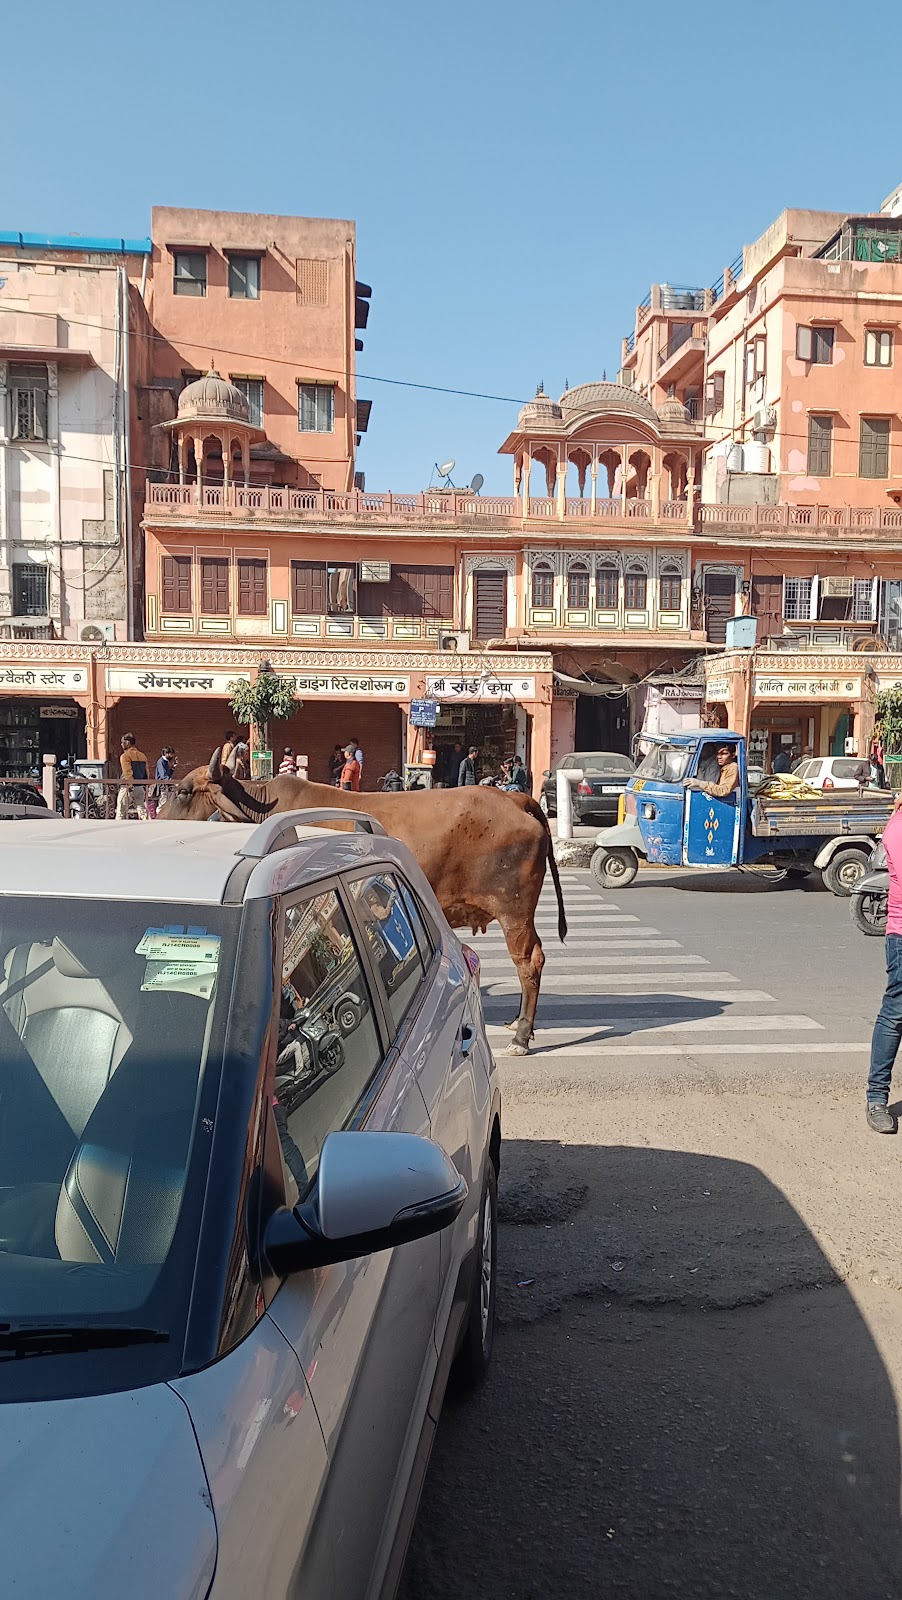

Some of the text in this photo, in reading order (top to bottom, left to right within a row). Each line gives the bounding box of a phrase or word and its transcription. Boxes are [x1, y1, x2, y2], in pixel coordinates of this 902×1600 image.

[40, 670, 66, 685] स्टोर
[137, 672, 214, 690] सैमसन्स
[299, 676, 329, 691] डाइंग
[433, 679, 446, 692] श्री
[665, 688, 681, 697] RAJ
[758, 678, 784, 693] शान्ति
[787, 682, 807, 693] लाल
